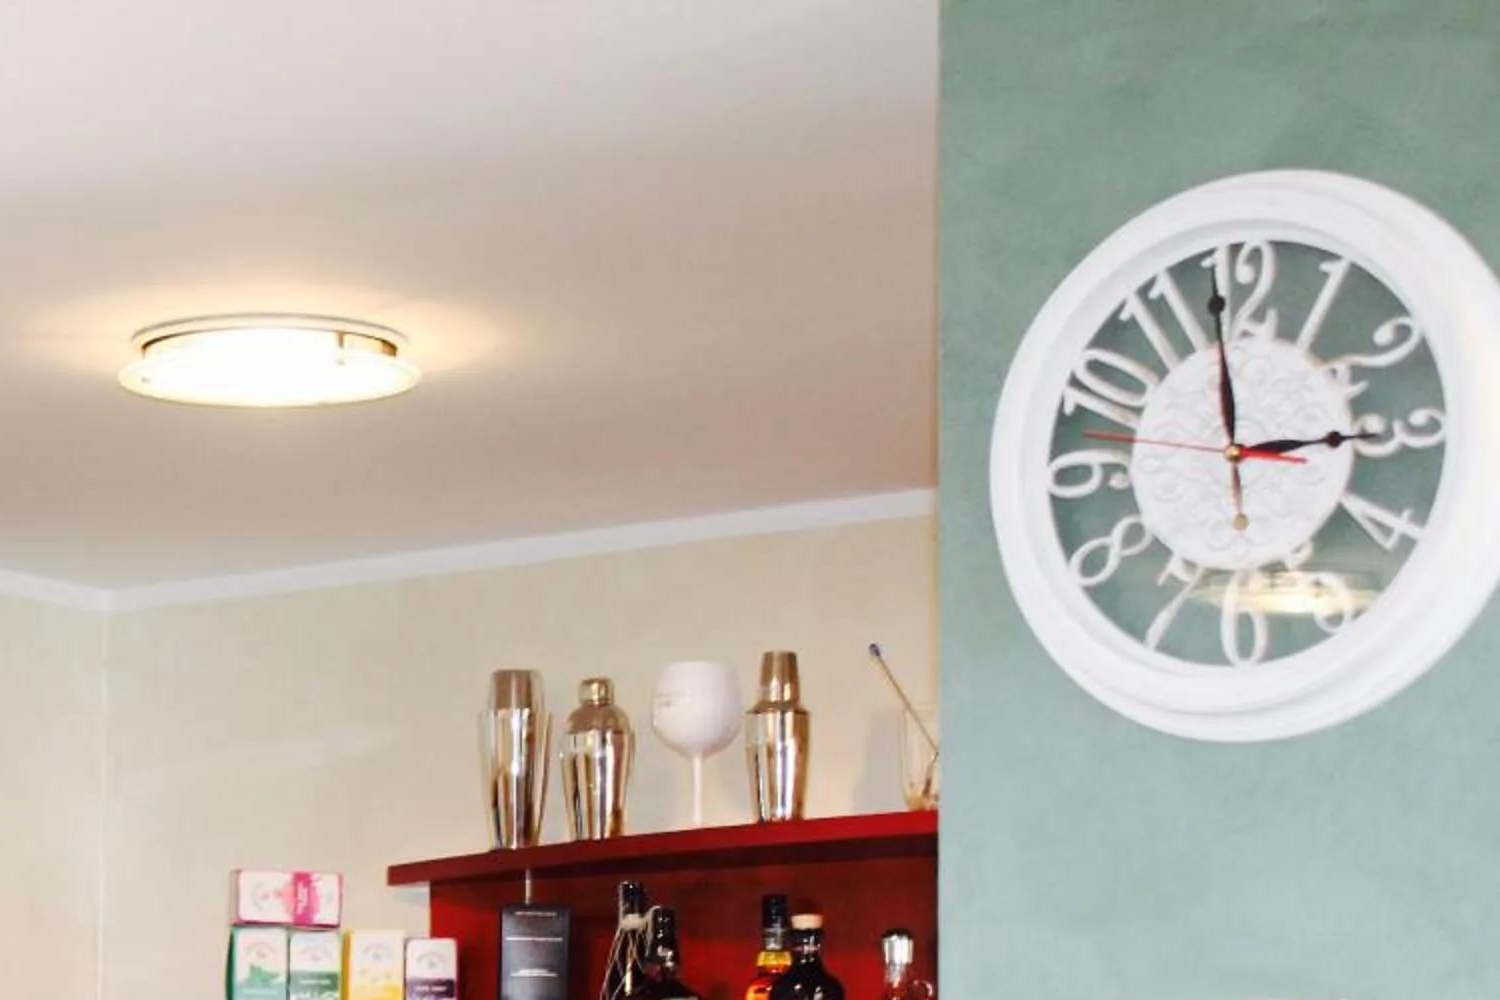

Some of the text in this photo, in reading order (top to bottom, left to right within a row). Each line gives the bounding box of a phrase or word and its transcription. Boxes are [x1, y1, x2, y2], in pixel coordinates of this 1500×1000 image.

[1119, 267, 1209, 374] 11
[1201, 239, 1277, 343] 12
[1299, 256, 1353, 349] 1
[1063, 347, 1161, 430] 10
[1319, 315, 1421, 400] 2
[1047, 449, 1132, 499] 9
[1352, 408, 1446, 458] 3
[1067, 513, 1154, 587] 8
[1341, 492, 1425, 550] 4
[1145, 552, 1203, 652] 7
[1220, 568, 1269, 668] 6
